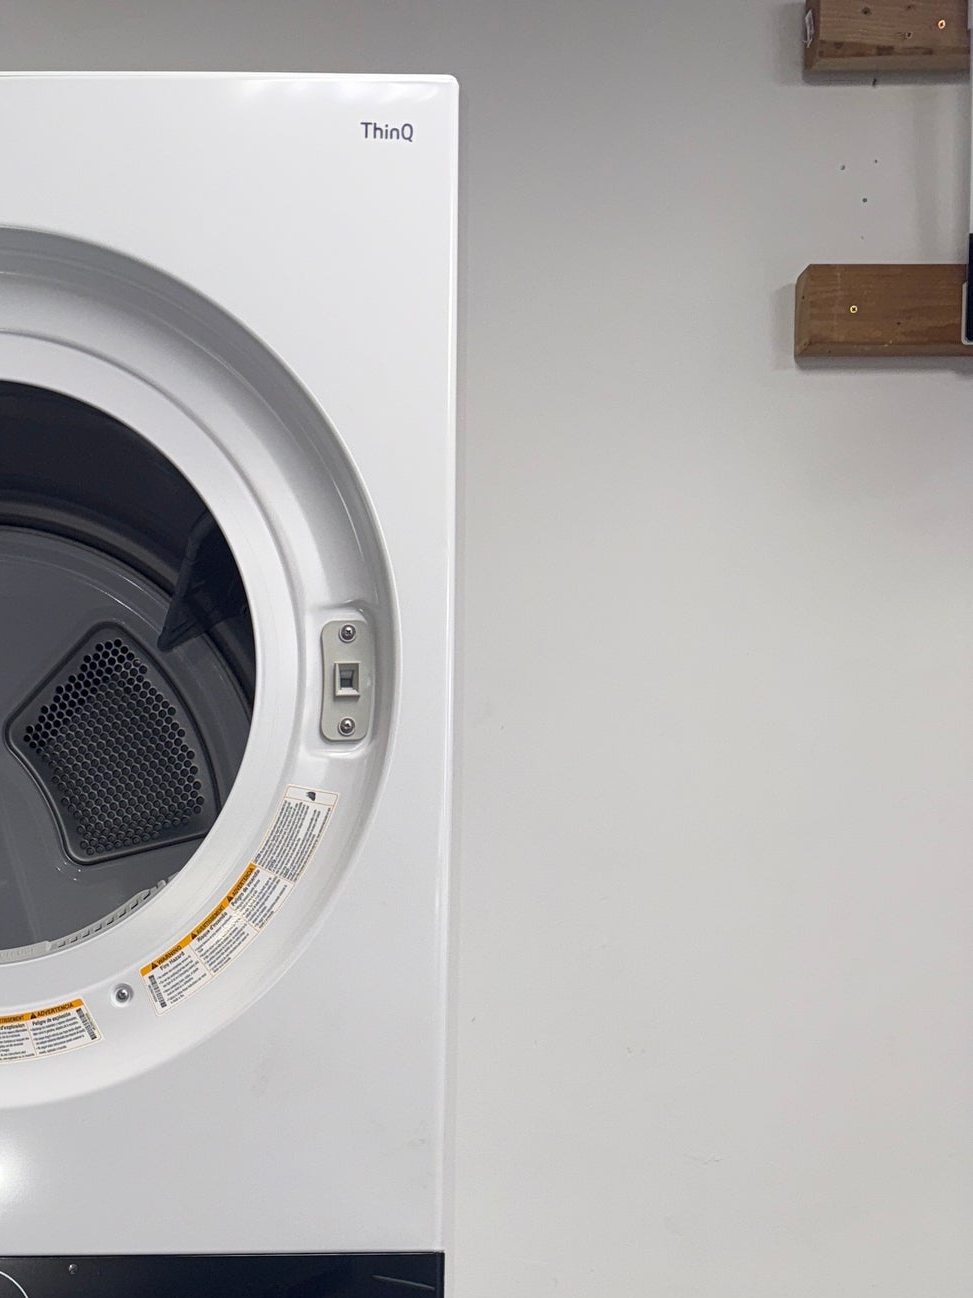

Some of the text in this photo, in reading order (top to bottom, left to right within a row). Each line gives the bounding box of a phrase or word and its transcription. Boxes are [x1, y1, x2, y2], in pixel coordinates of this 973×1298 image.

[360, 122, 413, 142] ThinQ
[157, 945, 182, 964] WARNING
[37, 1002, 74, 1017] ADVERTENCIA
